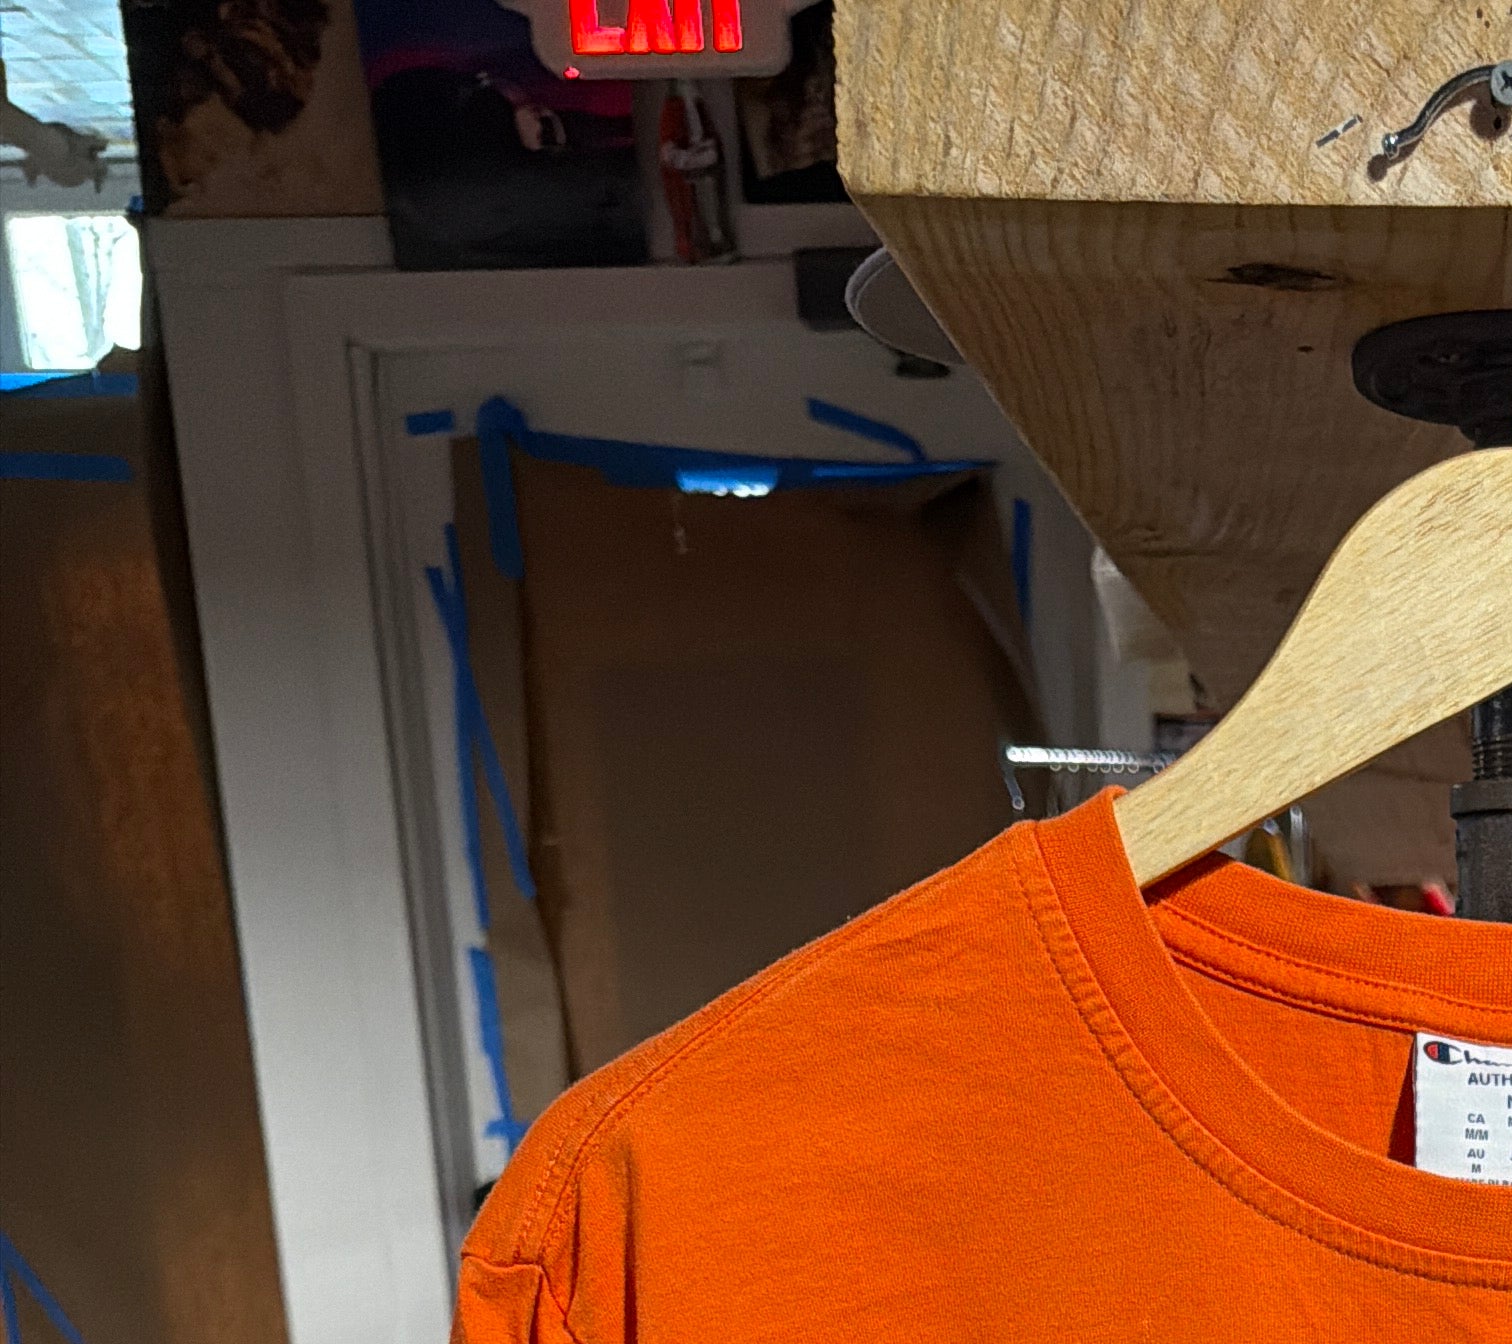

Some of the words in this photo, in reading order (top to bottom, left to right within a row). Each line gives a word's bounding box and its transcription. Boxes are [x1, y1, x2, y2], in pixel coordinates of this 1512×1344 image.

[1467, 1113, 1485, 1125] CA
[1465, 1129, 1489, 1141] M/M
[1467, 1149, 1485, 1159] AU
[1471, 1164, 1481, 1174] M
